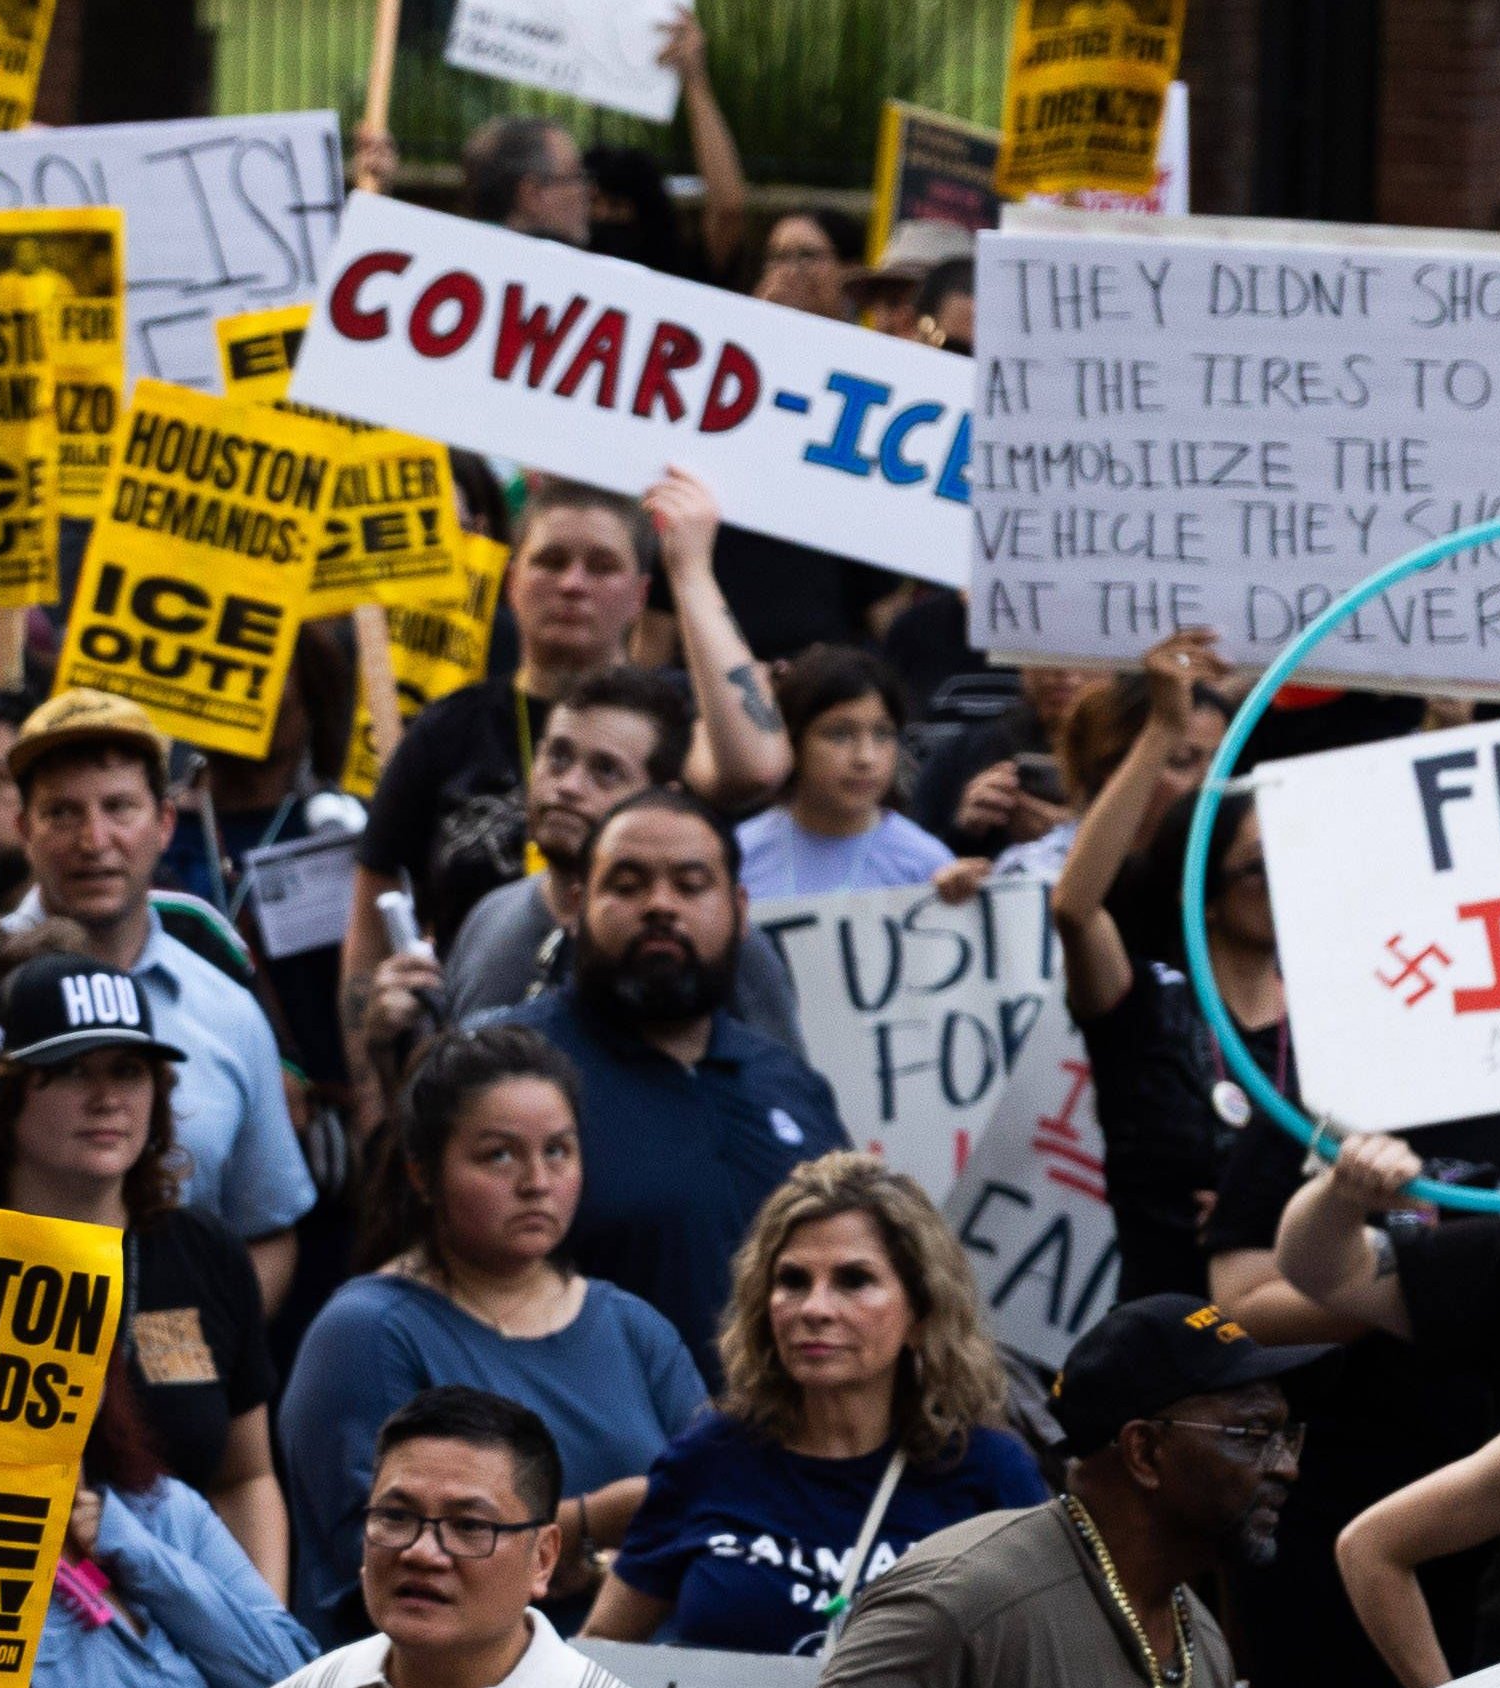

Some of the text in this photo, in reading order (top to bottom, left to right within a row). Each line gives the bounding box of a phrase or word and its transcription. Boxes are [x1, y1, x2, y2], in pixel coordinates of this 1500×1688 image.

[1004, 258, 1171, 335] THEY
[983, 350, 1494, 418] AT THE TIRES TO
[124, 409, 330, 512] HOUSTON
[1325, 436, 1431, 494] THE
[972, 505, 1209, 567] VEHICLE
[1226, 500, 1379, 561] THEY
[92, 561, 285, 657] ICE
[988, 580, 1058, 634] AT
[1091, 578, 1206, 636] THE
[78, 624, 271, 702] OUT!
[60, 974, 140, 1027] HOU
